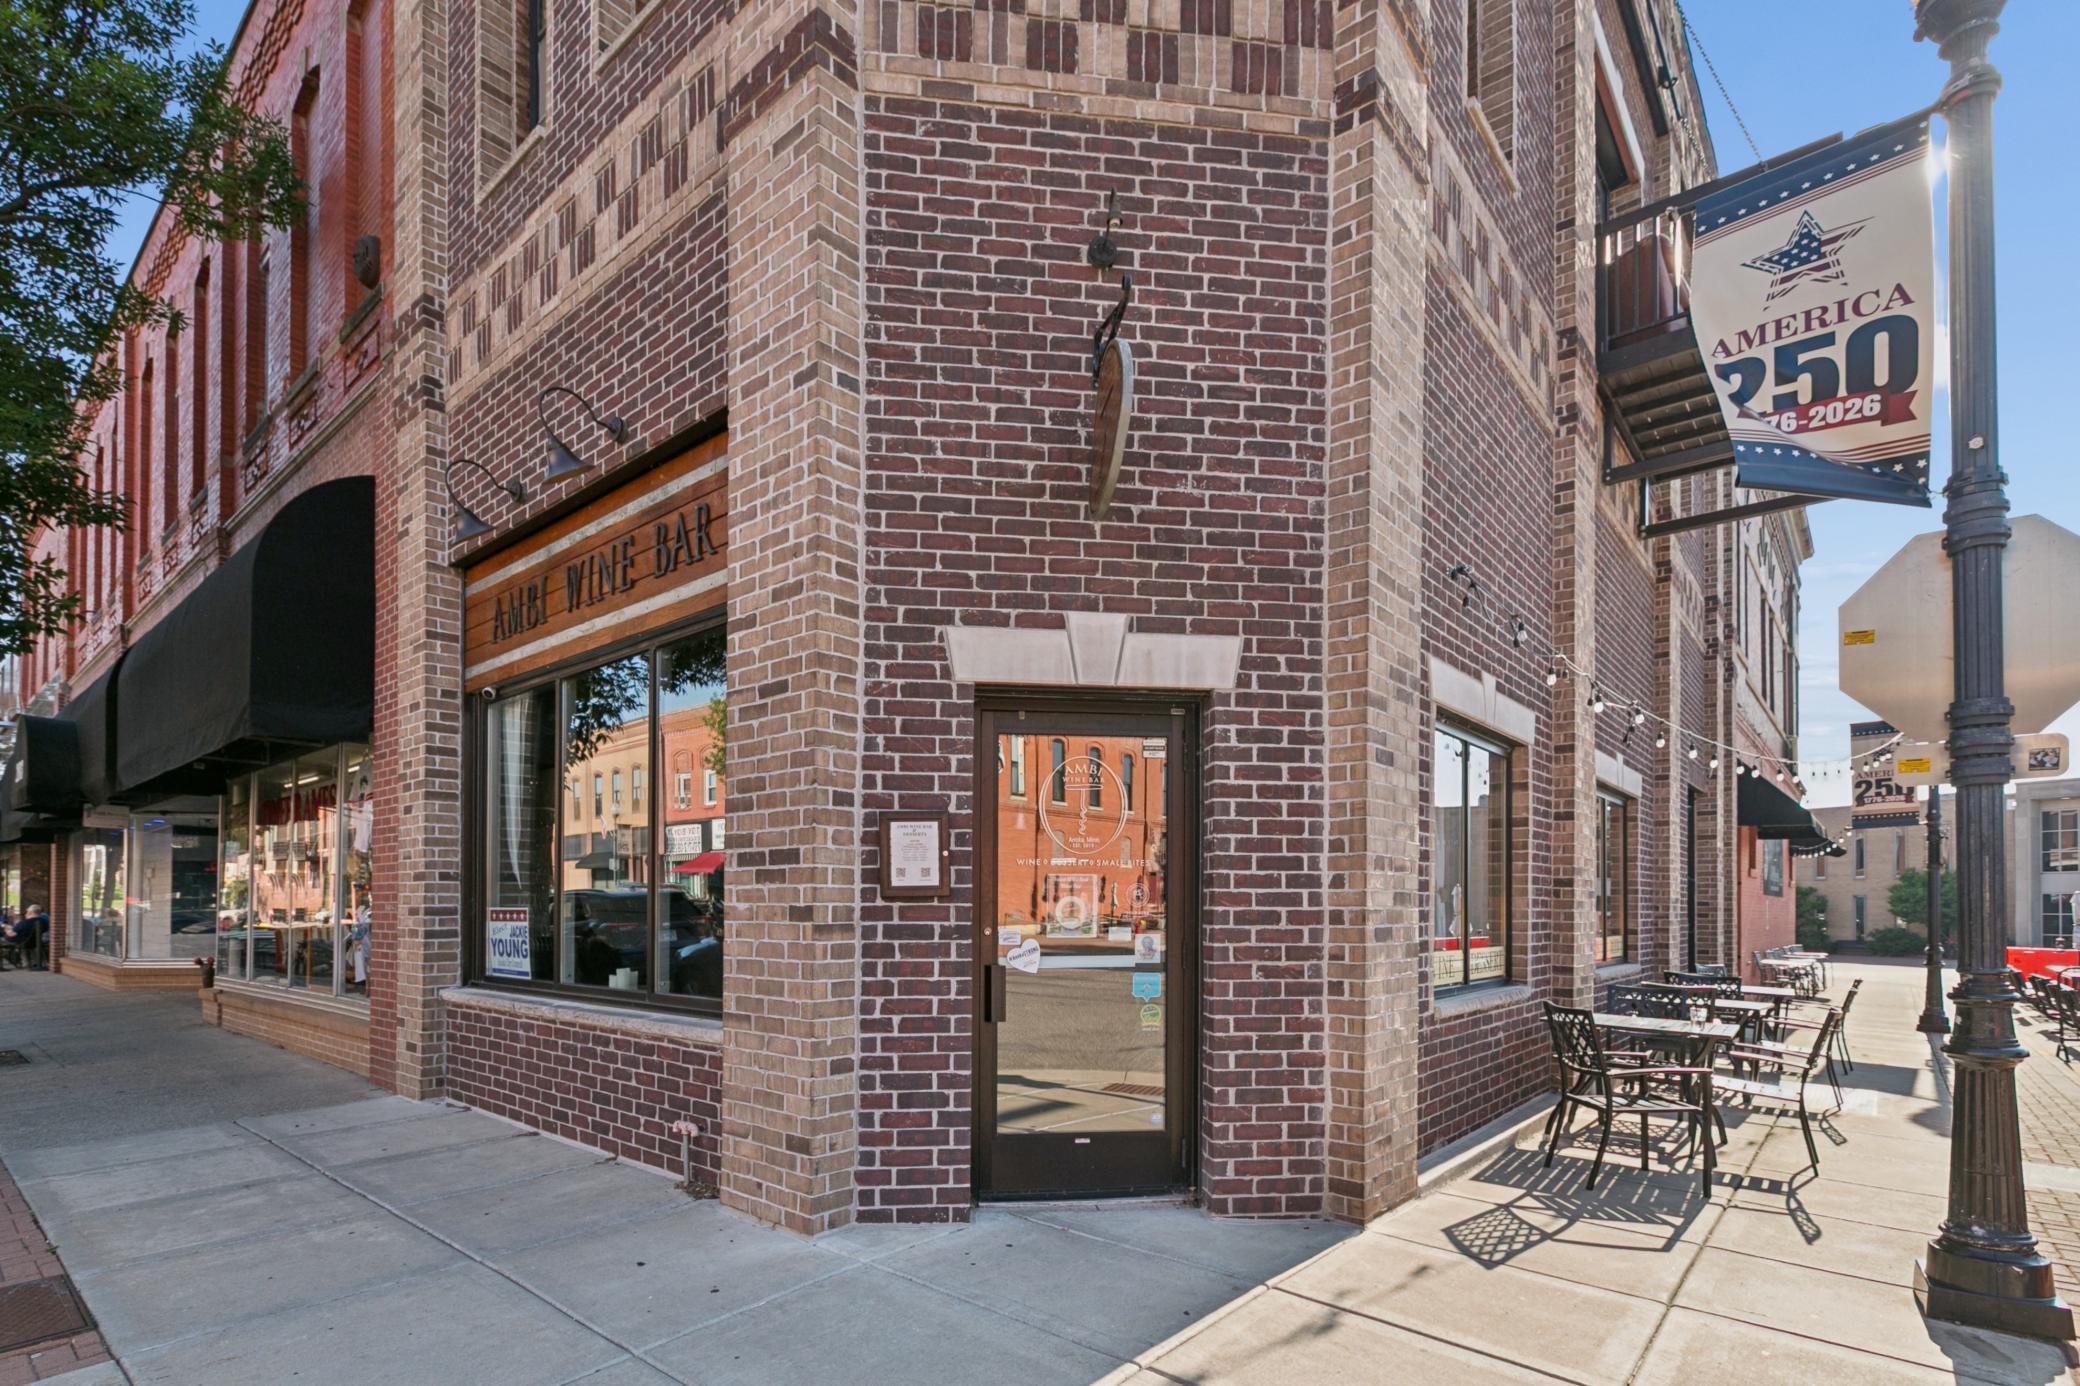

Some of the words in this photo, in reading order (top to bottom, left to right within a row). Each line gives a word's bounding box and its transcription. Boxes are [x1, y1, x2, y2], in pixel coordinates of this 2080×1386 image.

[1712, 282, 1915, 359] AMERICA
[1714, 314, 1919, 418] 250
[490, 575, 549, 644] AMBI
[564, 534, 636, 614] WINE
[652, 502, 718, 579] BAR
[1065, 764, 1102, 777] AMBI
[1856, 770, 1895, 779] AMERI
[1017, 858, 1041, 866] WINE
[510, 925, 528, 938] JACKIE
[490, 937, 529, 960] YOUNG
